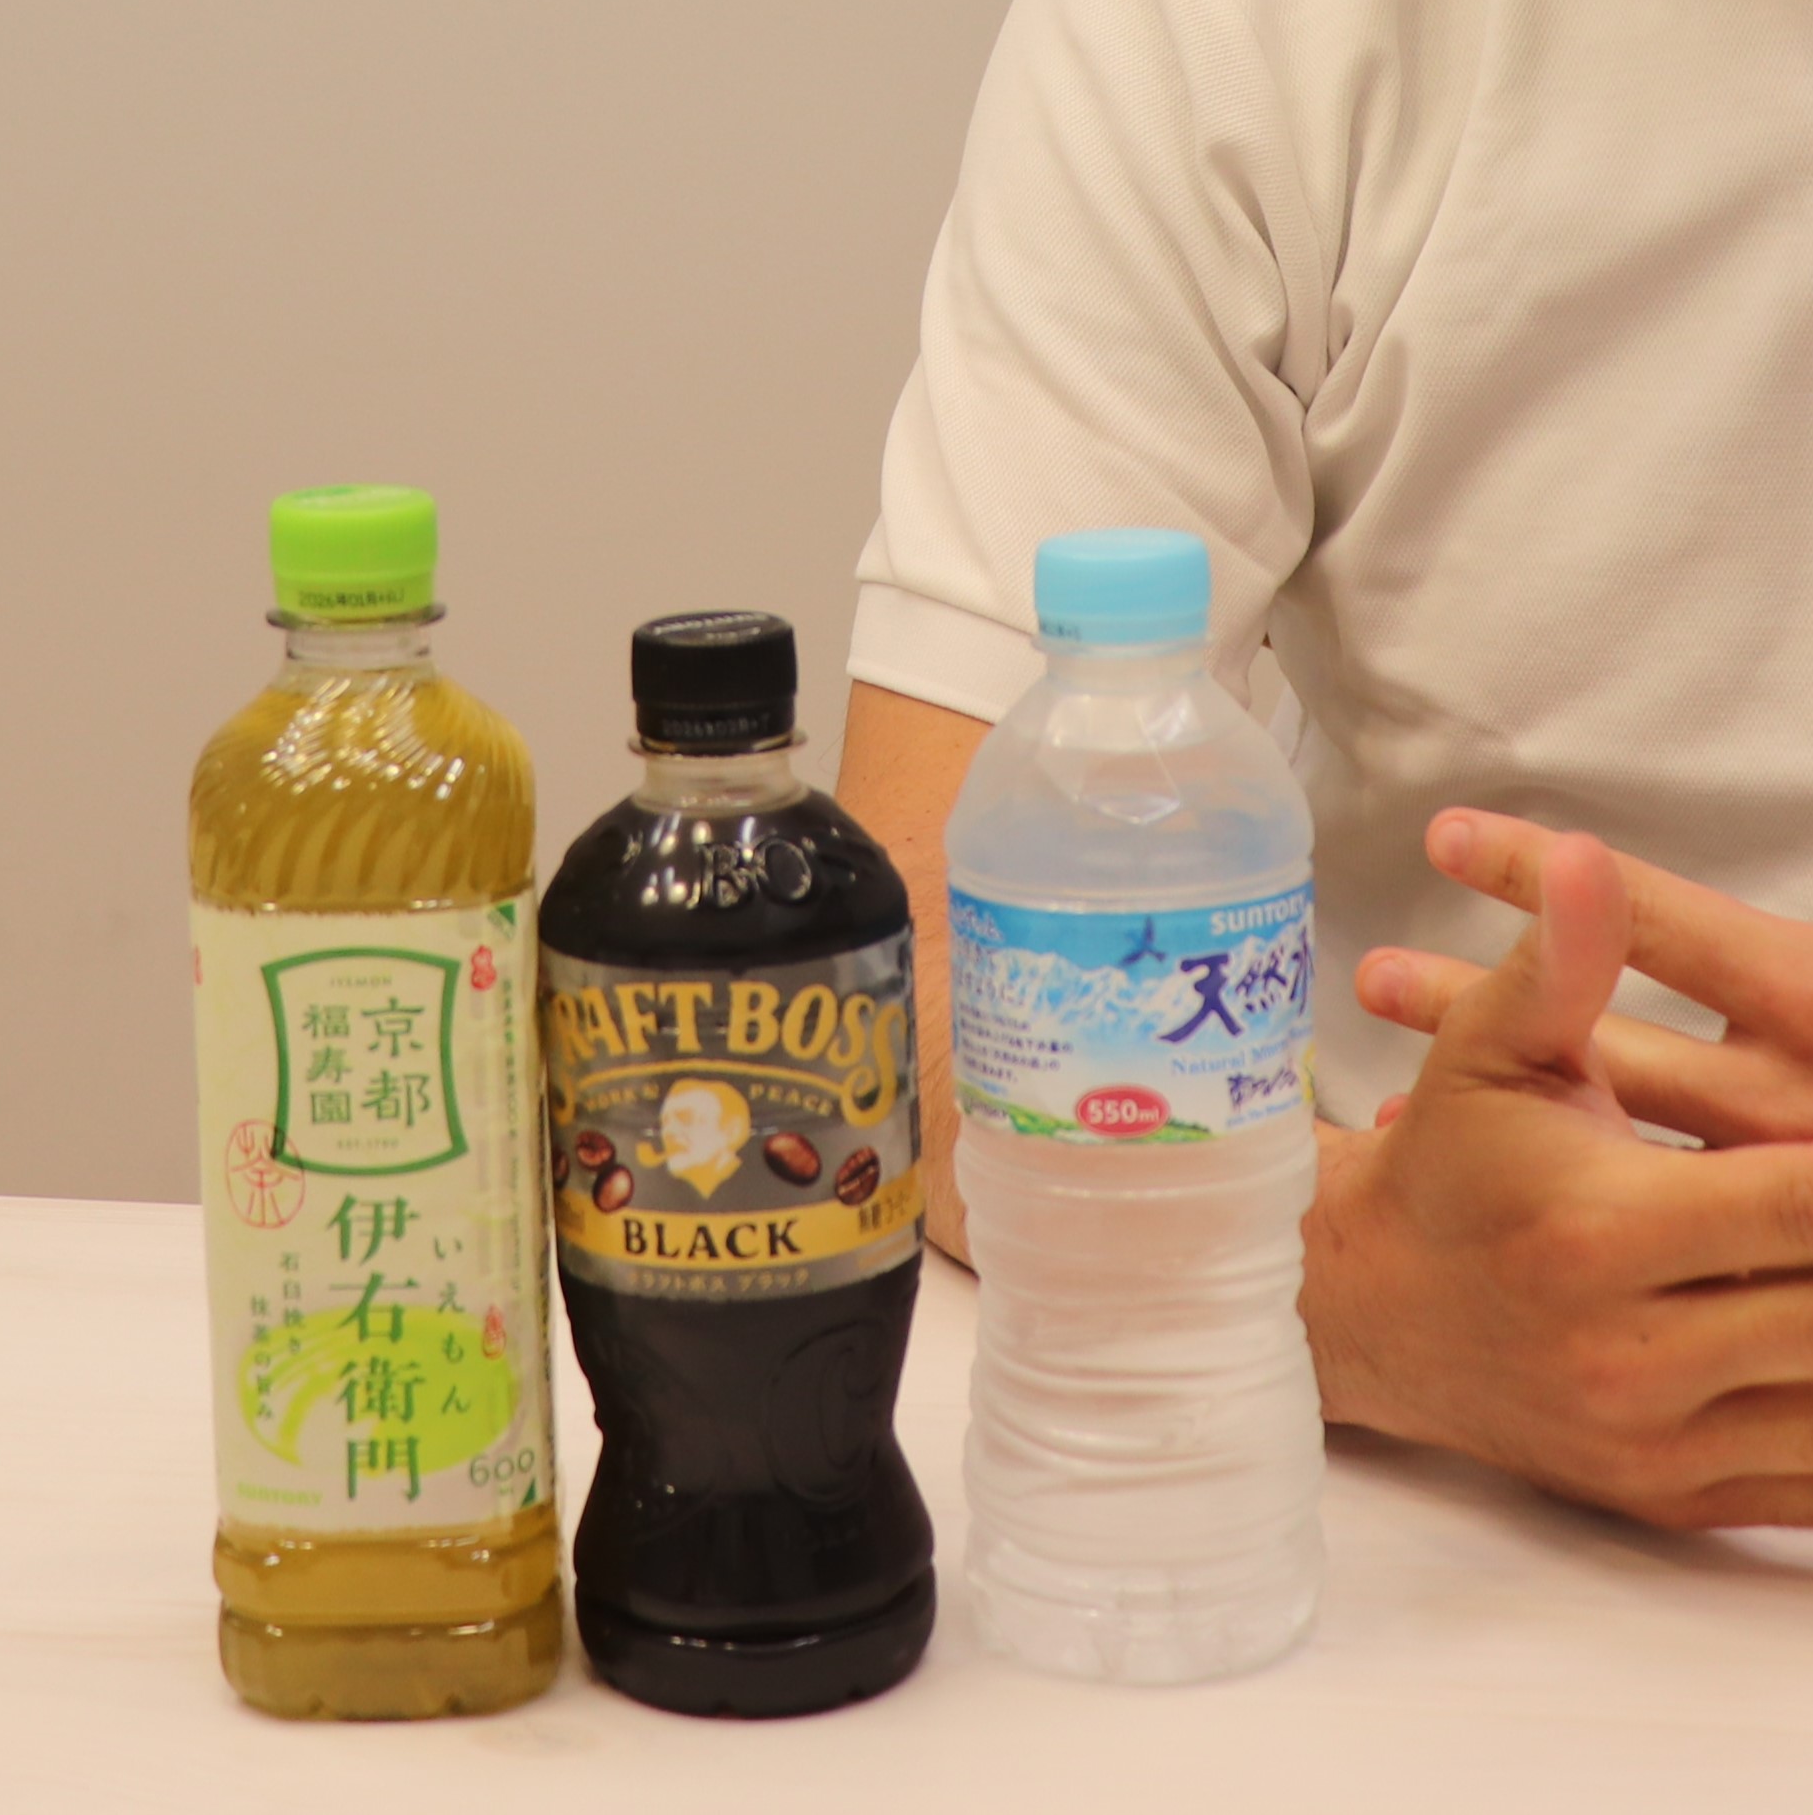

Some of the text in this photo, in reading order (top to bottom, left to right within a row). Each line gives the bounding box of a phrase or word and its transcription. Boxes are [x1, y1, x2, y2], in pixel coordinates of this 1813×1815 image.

[360, 996, 431, 1128] 京都
[726, 979, 908, 1129] BOSS
[748, 1084, 834, 1117] PEACE
[623, 1215, 802, 1259] BLACK
[325, 1192, 427, 1503] 伊右衛門
[432, 1237, 472, 1415] いえもん
[469, 1447, 536, 1488] 600
